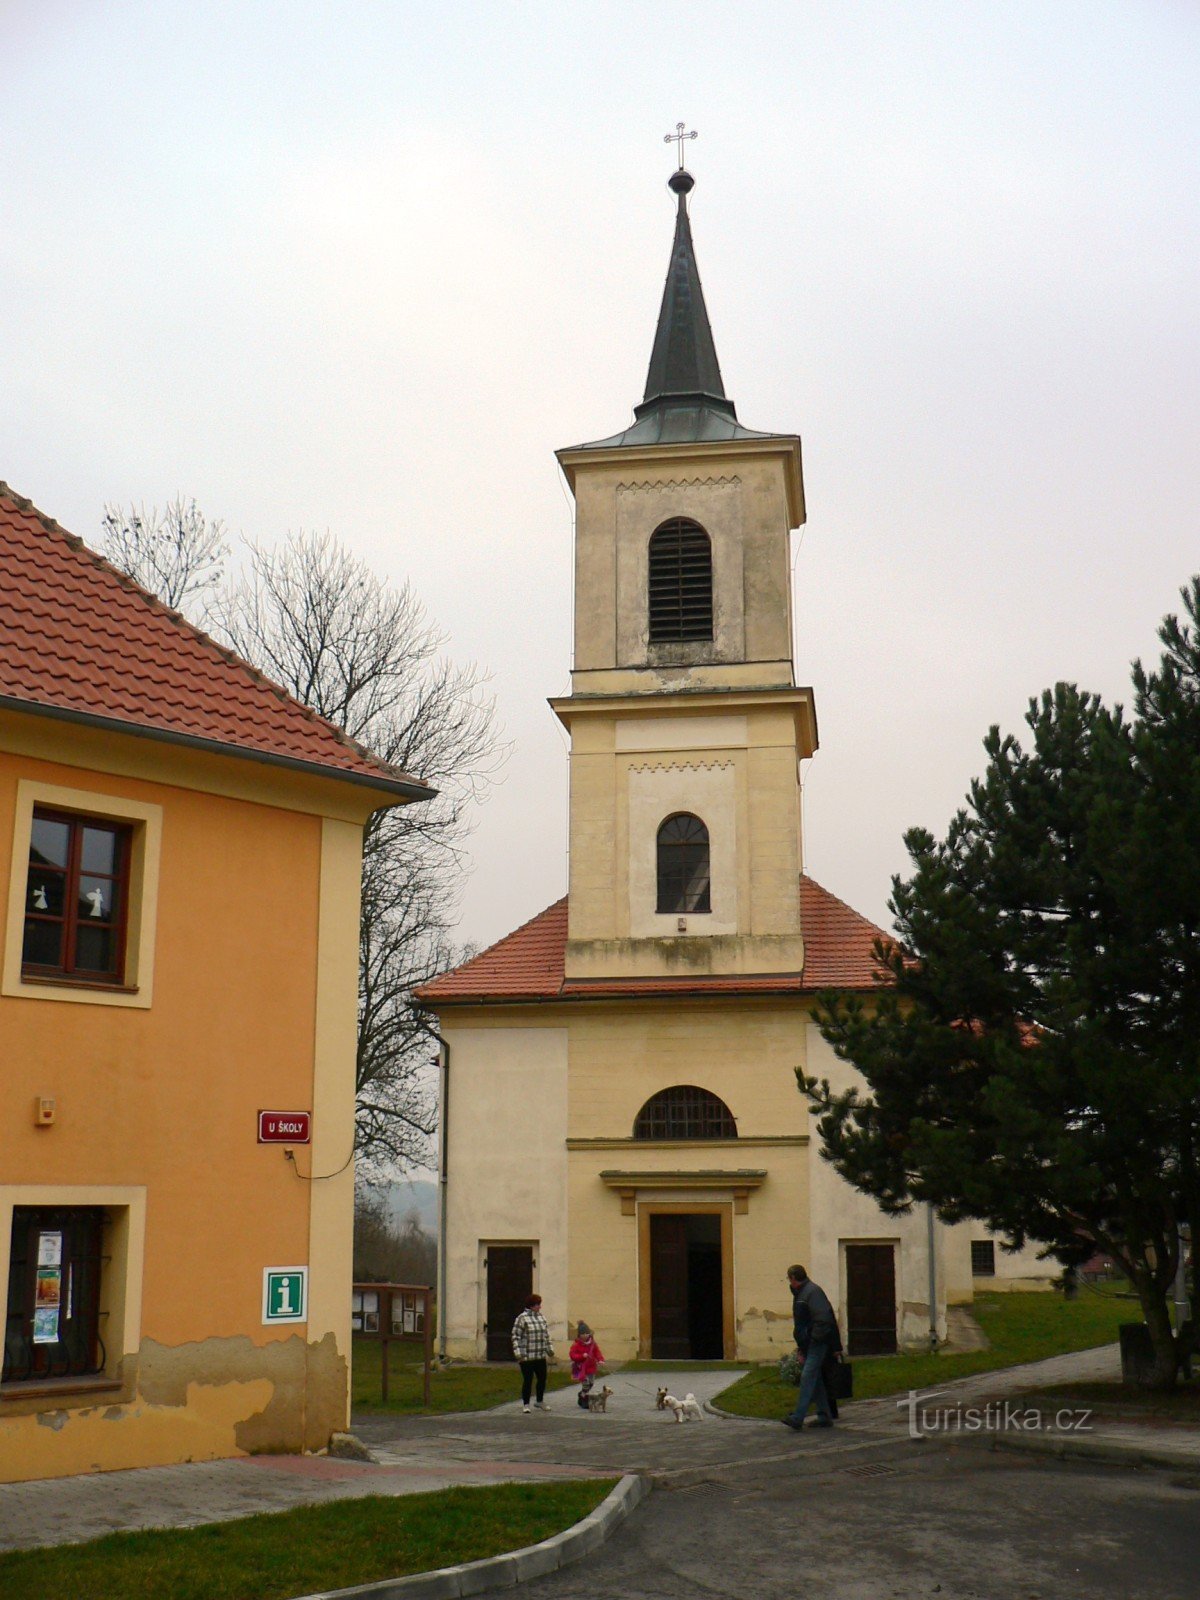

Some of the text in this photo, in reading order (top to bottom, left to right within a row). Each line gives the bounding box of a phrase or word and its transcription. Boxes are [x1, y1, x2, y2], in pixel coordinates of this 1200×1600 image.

[269, 1120, 303, 1133] U ŠKOLY
[277, 1277, 293, 1313] i
